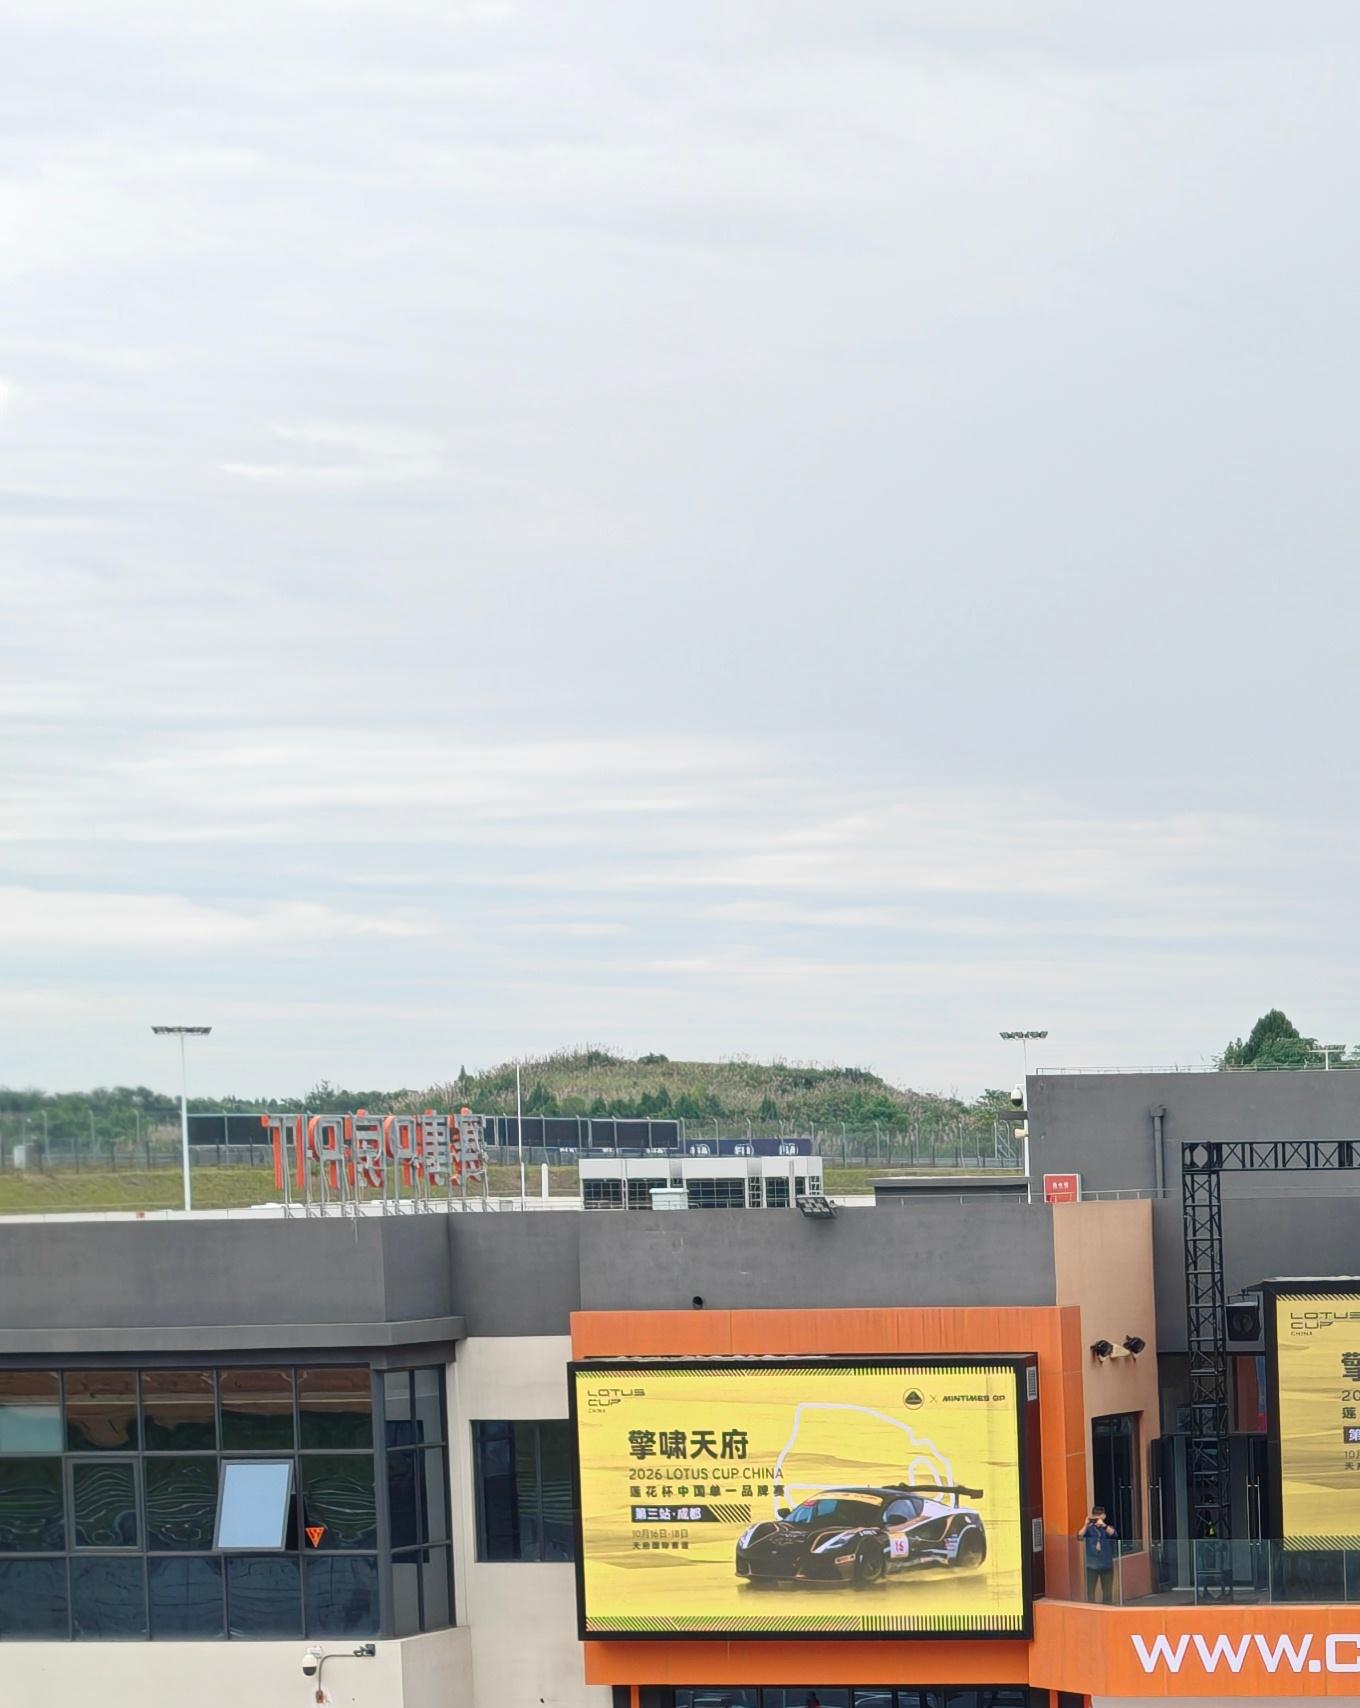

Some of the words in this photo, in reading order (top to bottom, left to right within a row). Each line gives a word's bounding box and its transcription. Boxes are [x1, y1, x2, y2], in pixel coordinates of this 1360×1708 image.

[1290, 1321, 1333, 1330] CUP
[587, 1388, 646, 1398] LOTUS
[588, 1398, 622, 1407] CUP
[628, 1428, 749, 1460] 擎啸天府
[629, 1468, 662, 1481] 2026
[666, 1467, 709, 1480] LOTUS
[712, 1467, 740, 1480] CUP
[742, 1467, 784, 1480] CHINA
